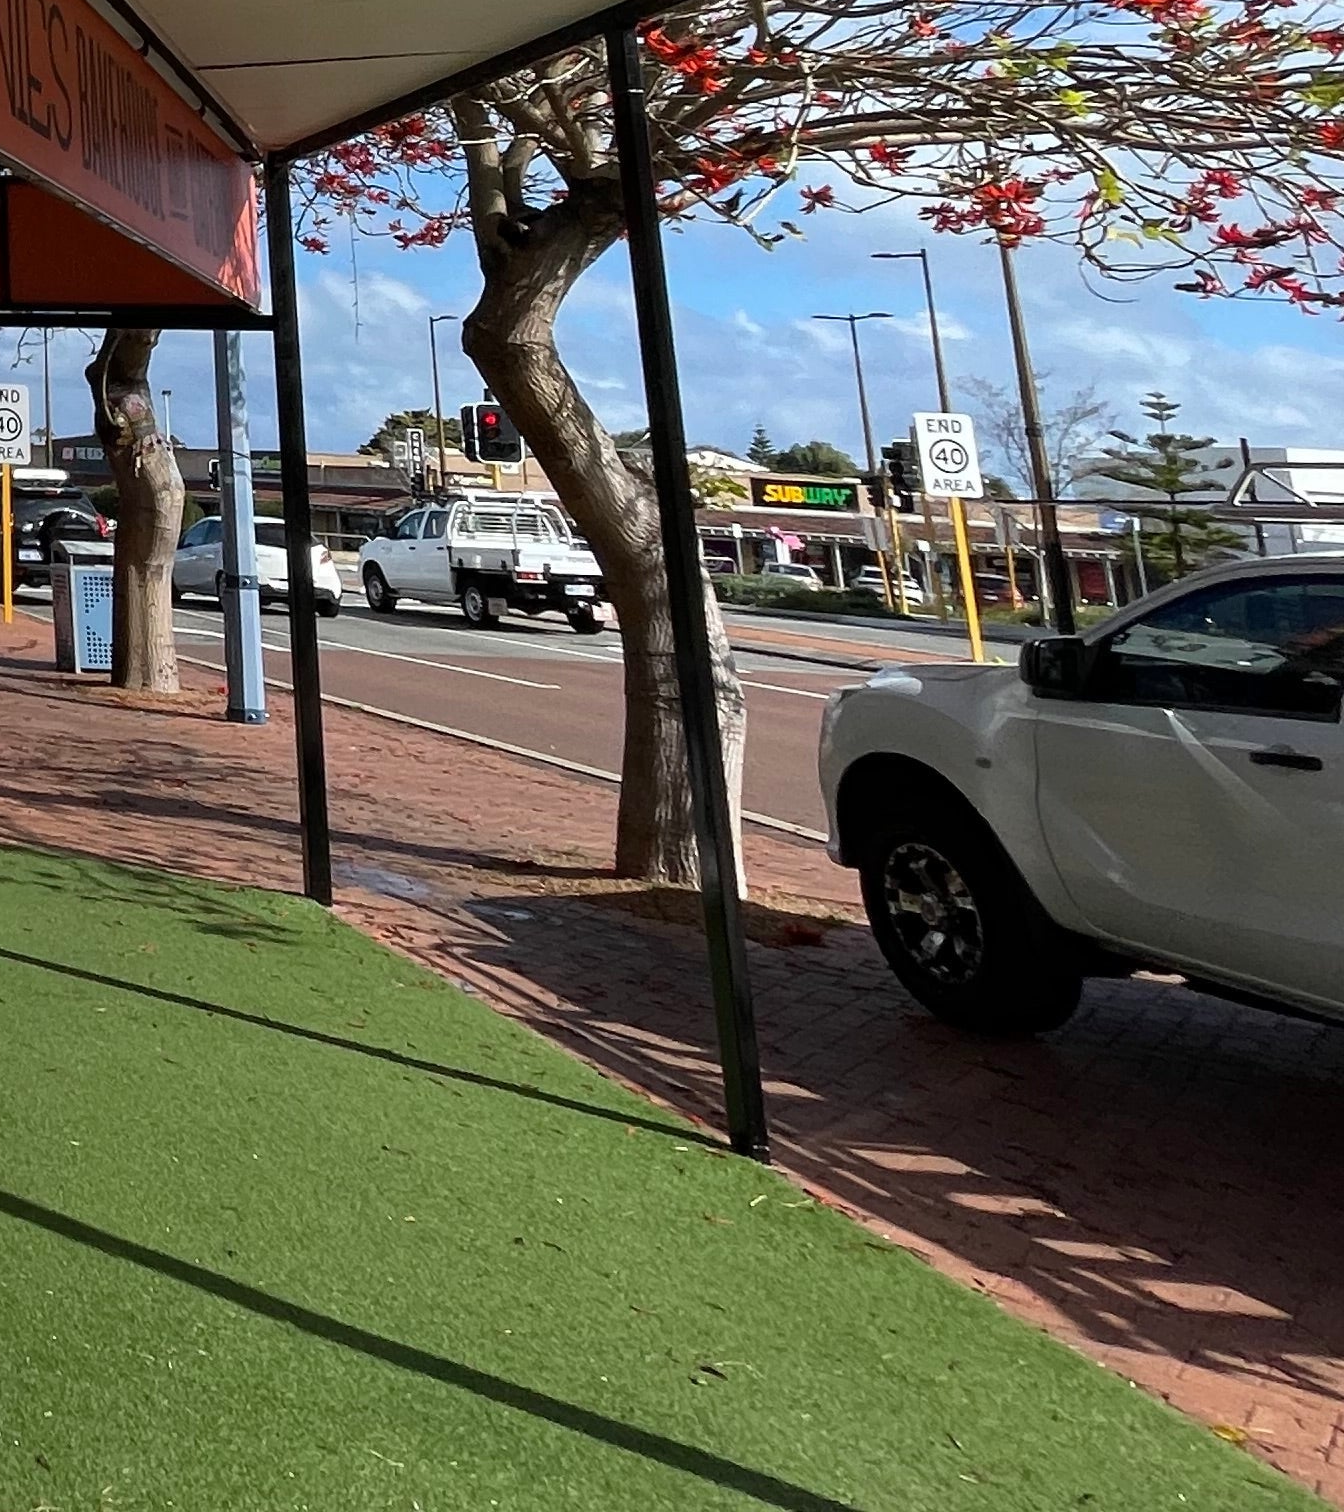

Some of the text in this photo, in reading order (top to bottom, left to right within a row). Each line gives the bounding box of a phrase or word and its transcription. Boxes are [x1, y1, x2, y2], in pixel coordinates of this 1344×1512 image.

[926, 418, 963, 434] END
[934, 447, 964, 466] 40
[932, 478, 977, 493] AREA
[763, 484, 853, 506] SUBWAY
